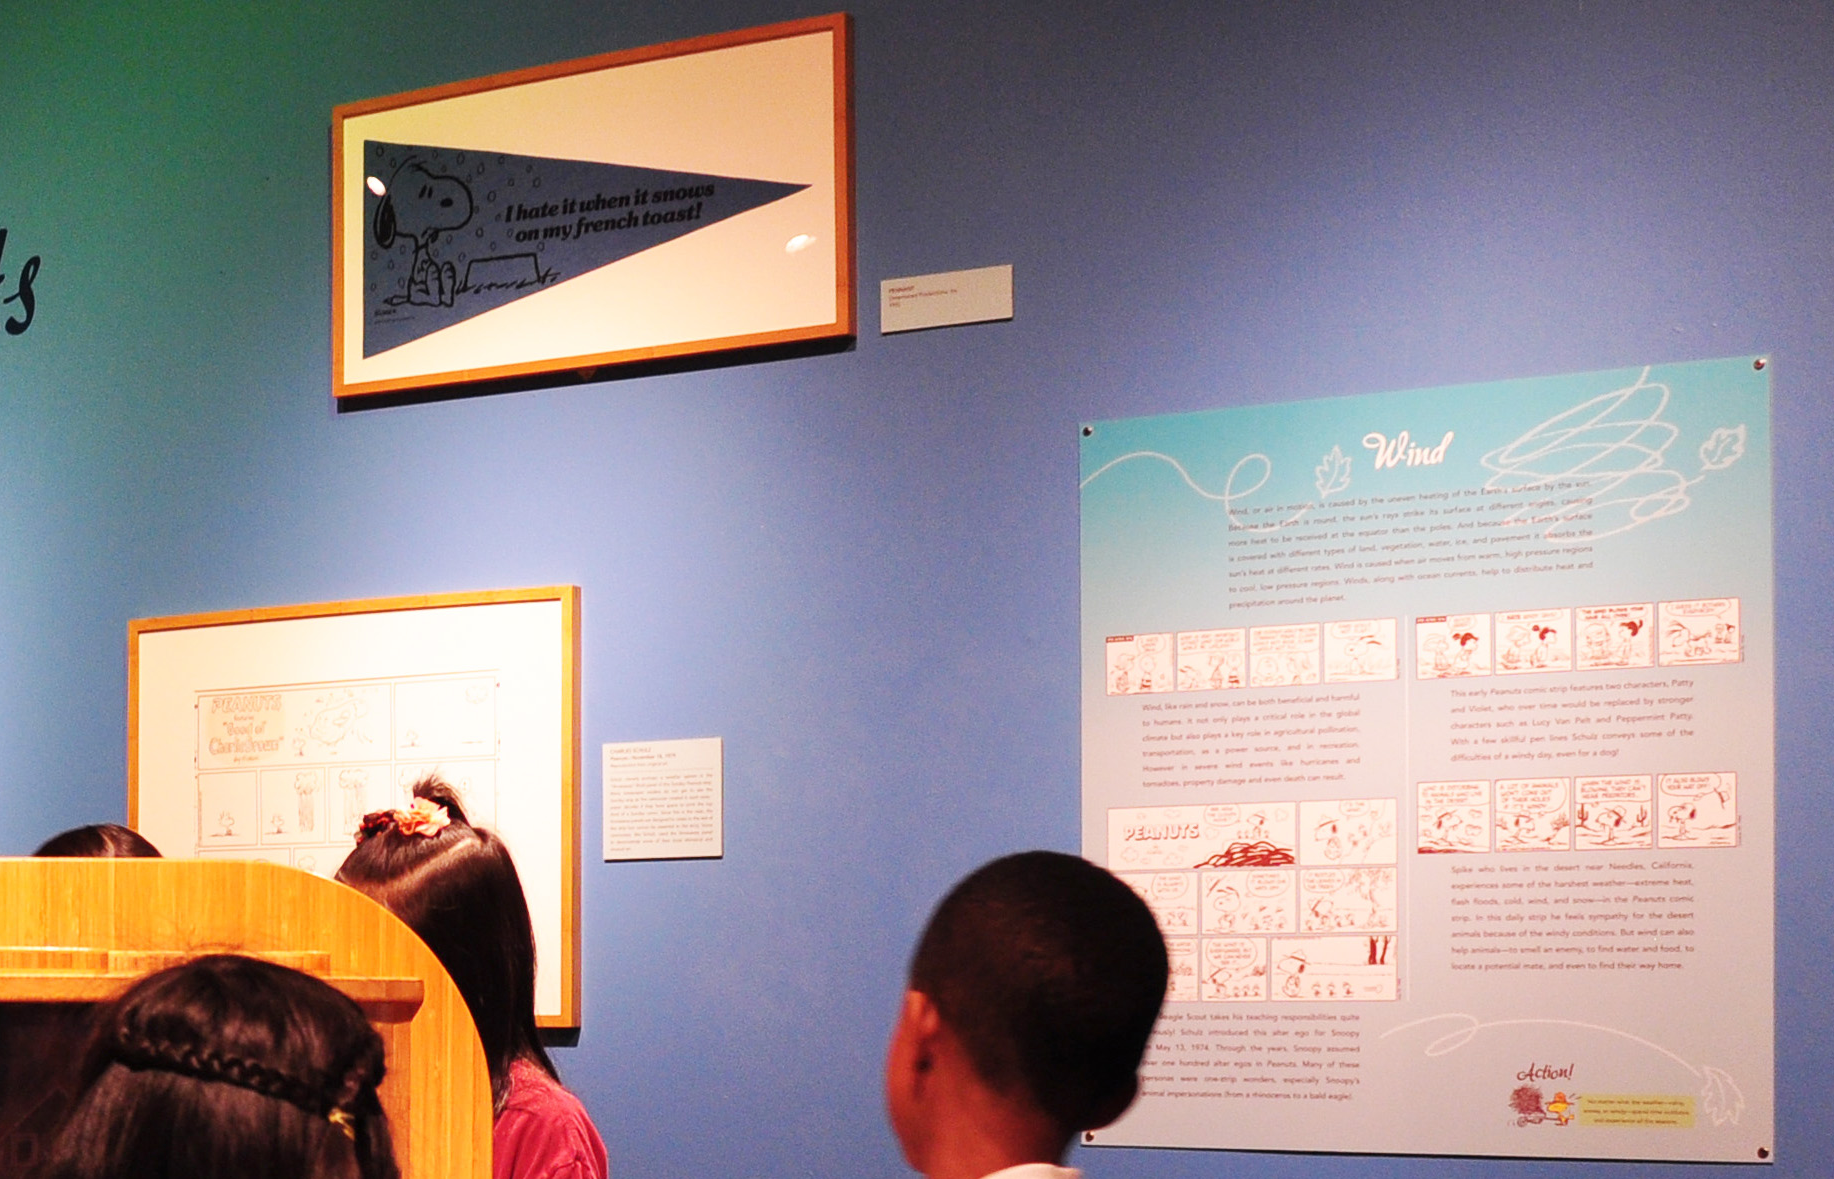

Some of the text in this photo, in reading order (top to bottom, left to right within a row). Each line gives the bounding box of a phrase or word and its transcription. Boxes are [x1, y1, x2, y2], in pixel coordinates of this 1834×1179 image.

[504, 183, 715, 222] I hate it when it snows
[515, 202, 703, 243] on my french toast!
[1362, 430, 1455, 470] Wind
[1450, 688, 1466, 696] This
[1468, 687, 1487, 697] early
[1489, 686, 1521, 694] Peanuts
[1523, 685, 1546, 693] comic
[1549, 684, 1567, 693] strip
[1569, 682, 1603, 691] features
[1671, 679, 1693, 689] Patty
[211, 694, 282, 714] PEANUTS
[1450, 704, 1465, 712] and
[1497, 702, 1514, 710] who
[1561, 700, 1586, 708] would
[1603, 698, 1640, 708] replaced
[1657, 695, 1693, 706] stronger
[1450, 719, 1491, 728] characters
[1531, 717, 1550, 727] Lucy
[1595, 715, 1611, 723] and
[1615, 713, 1665, 724] Peppermint
[1450, 736, 1469, 744] With
[1481, 735, 1496, 743] few
[1500, 734, 1526, 742] skillful
[1529, 735, 1545, 743] pen
[1549, 733, 1567, 741] lines
[1571, 732, 1598, 740] Schulz
[1601, 732, 1635, 740] conveys
[1679, 728, 1694, 736] the
[1450, 752, 1491, 761] difficulties
[1511, 751, 1534, 760] windy
[1123, 823, 1200, 841] PEANUTS
[1451, 864, 1473, 873] Spike
[1534, 863, 1548, 871] the
[1554, 879, 1588, 887] harshest
[1505, 913, 1524, 921] daily
[1528, 912, 1546, 921] strip
[1588, 912, 1628, 921] sympathy
[1648, 911, 1662, 919] the
[1517, 1062, 1574, 1082] Action!
